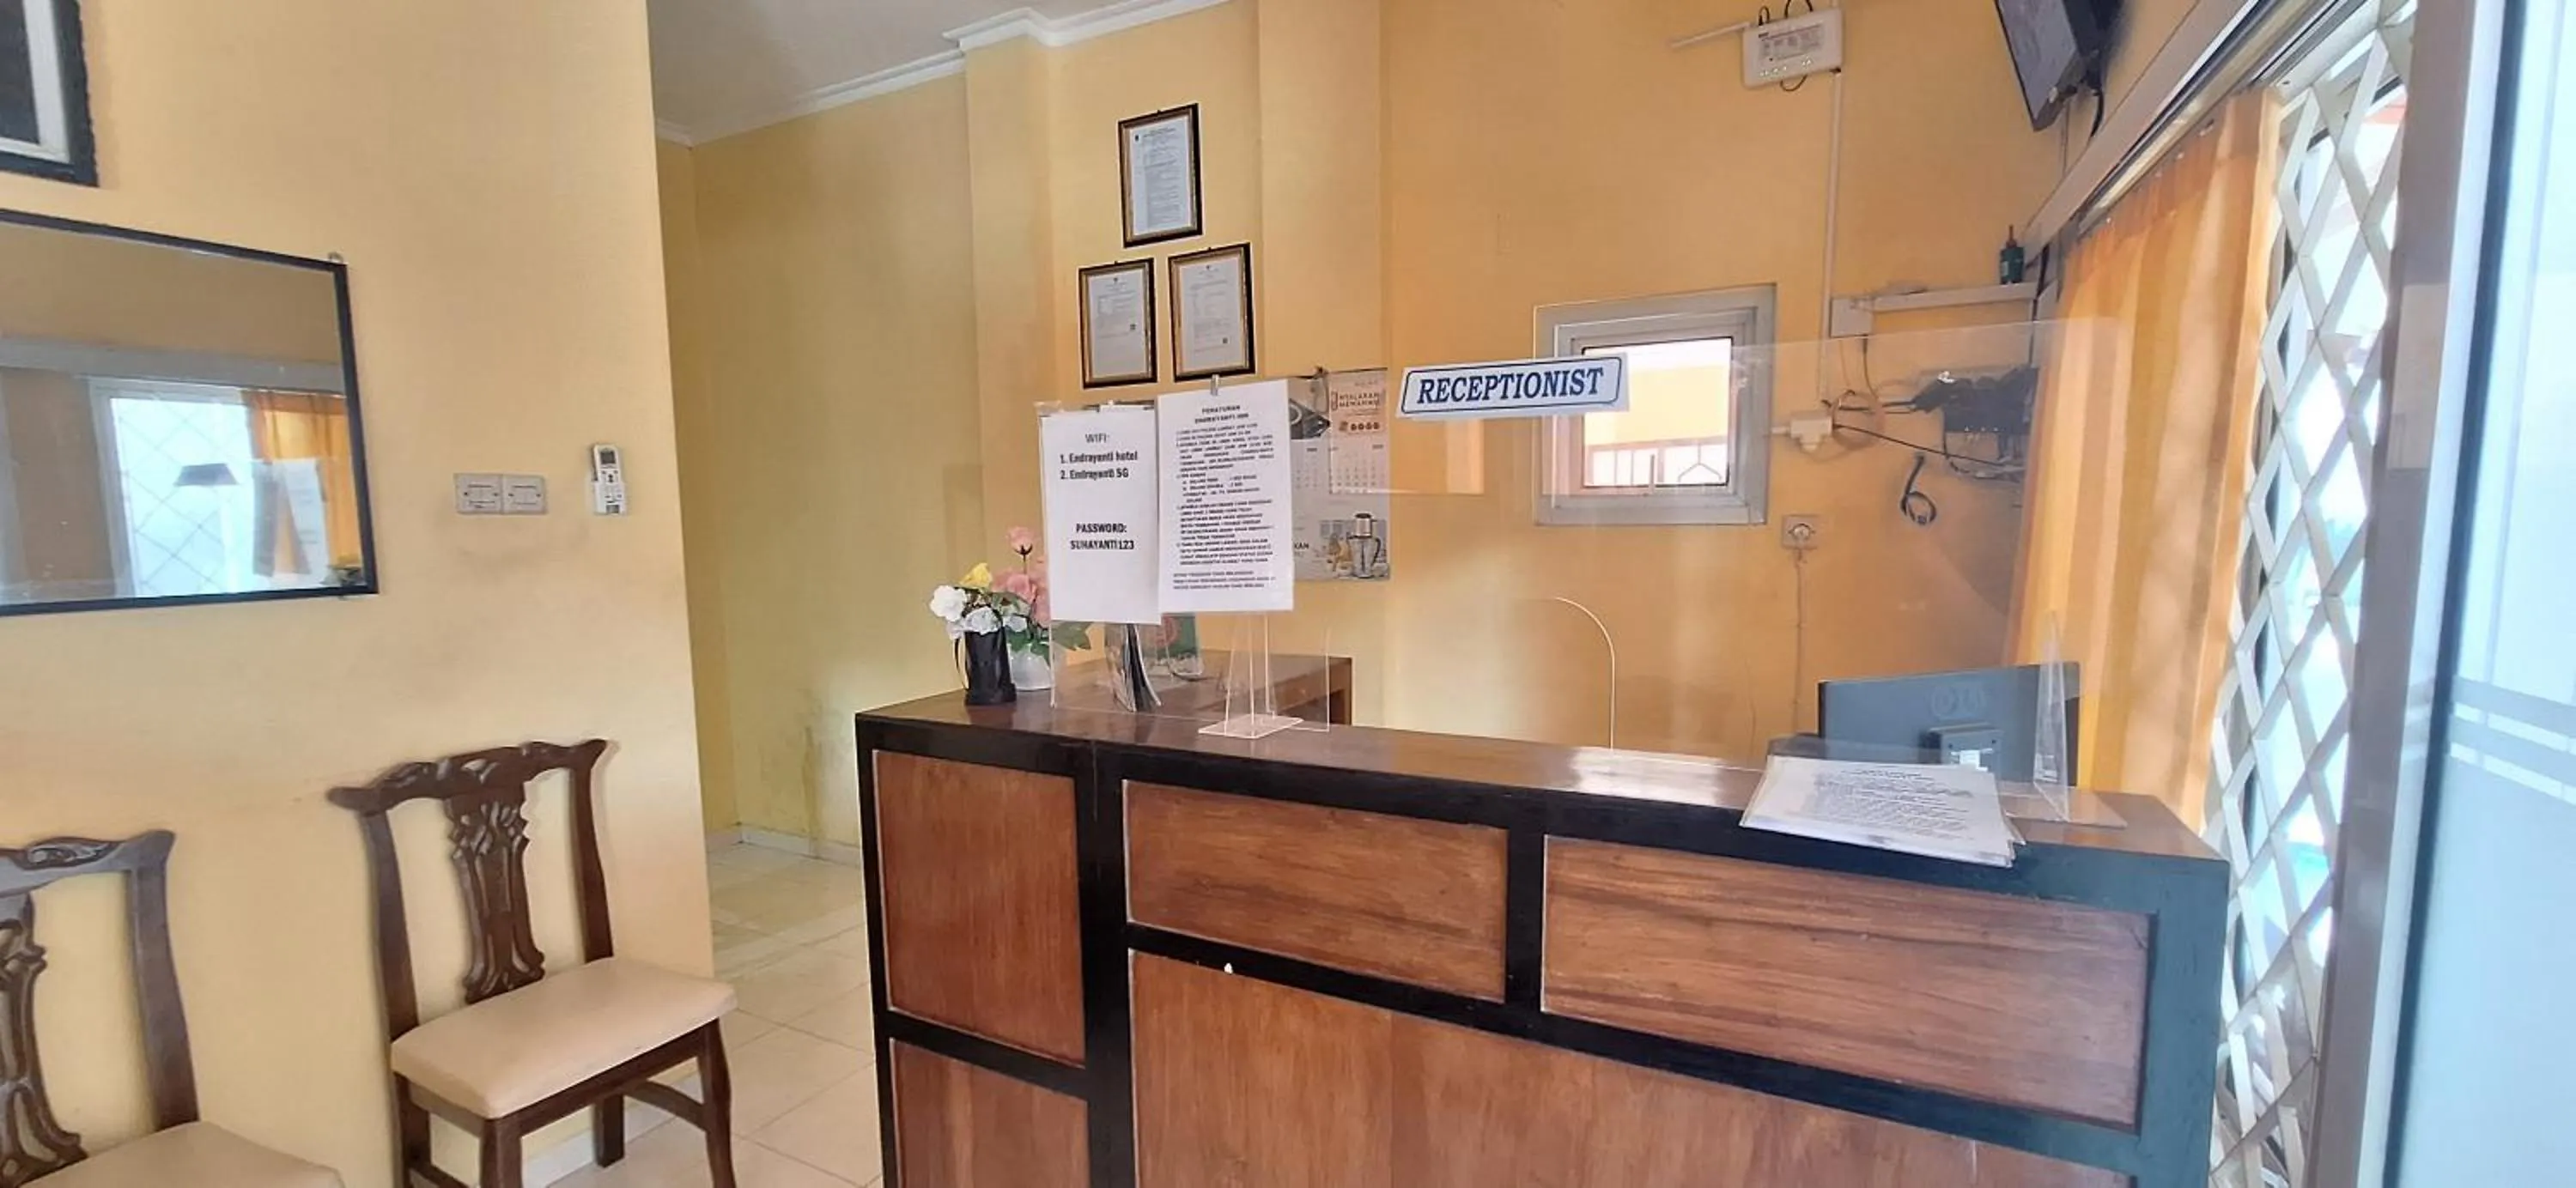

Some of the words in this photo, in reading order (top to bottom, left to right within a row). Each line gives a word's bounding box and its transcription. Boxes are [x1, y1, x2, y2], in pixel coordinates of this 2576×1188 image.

[1417, 367, 1604, 403] RECEPTIONIST
[1060, 454, 1069, 464] 1.
[1115, 451, 1139, 462] hotel
[1060, 470, 1069, 481] 2.
[1076, 523, 1127, 533] PASSWORD:
